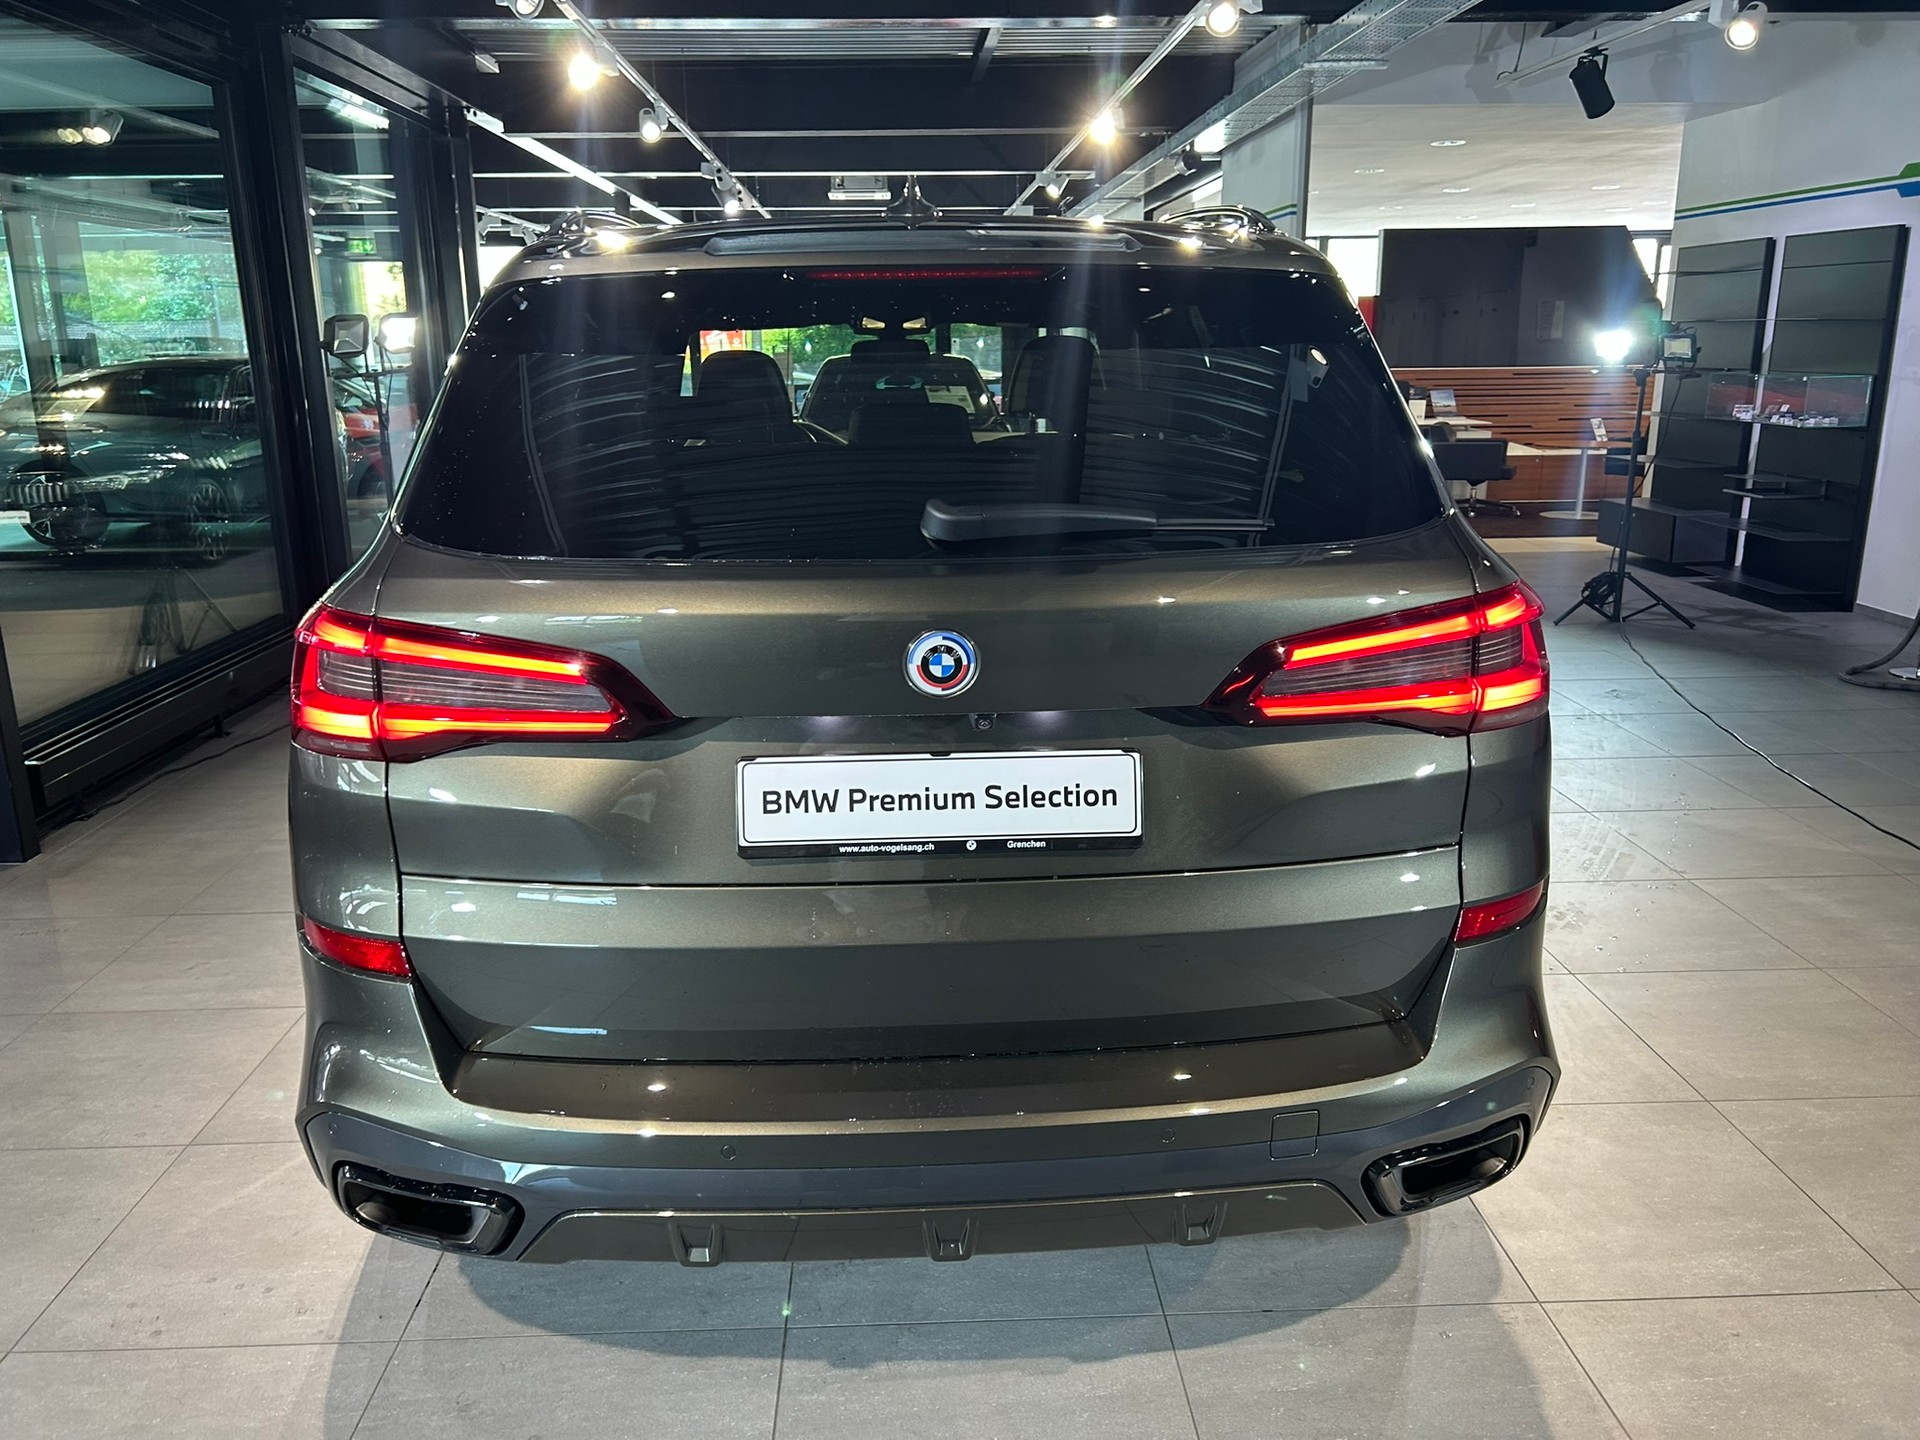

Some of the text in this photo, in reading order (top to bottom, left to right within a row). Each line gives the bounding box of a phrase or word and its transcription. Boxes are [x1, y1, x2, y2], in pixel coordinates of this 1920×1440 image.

[924, 645, 960, 659] BMW
[762, 784, 1118, 815] BMW Premium Selection
[839, 843, 935, 853] www.auto-vogelsang.ch
[1007, 840, 1046, 849] Grenchen
